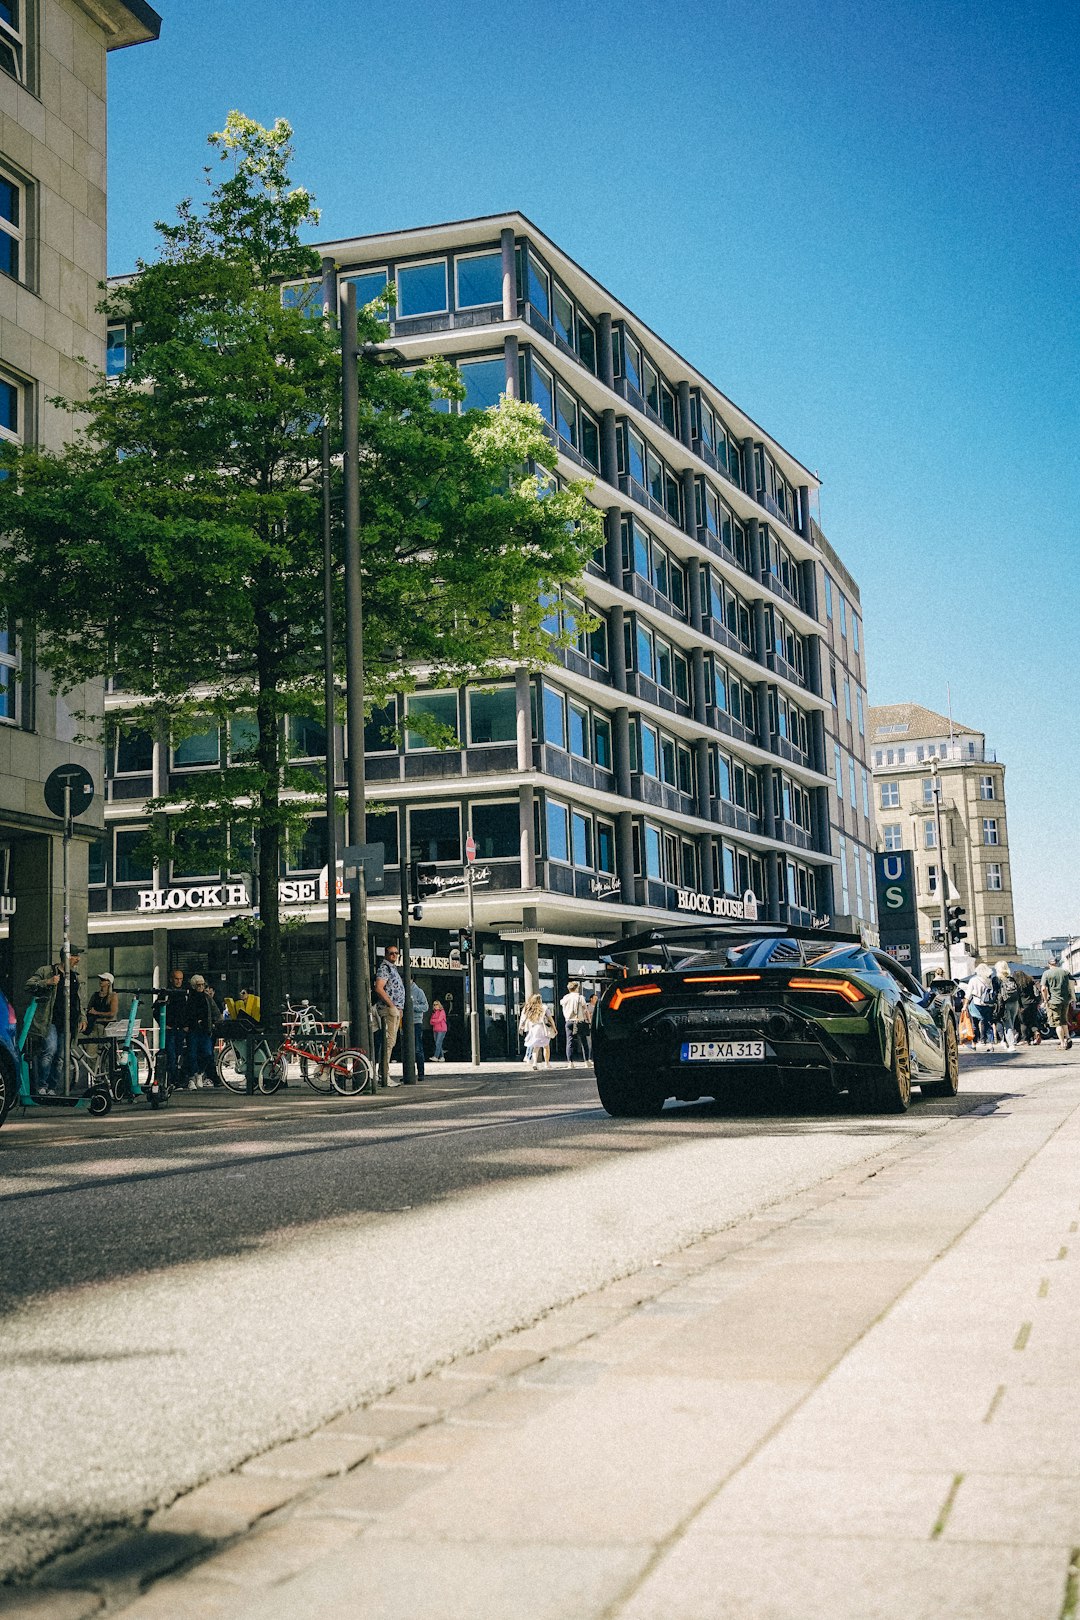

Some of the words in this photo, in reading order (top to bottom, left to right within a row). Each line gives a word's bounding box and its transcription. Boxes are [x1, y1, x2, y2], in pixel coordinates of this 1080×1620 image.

[884, 858, 902, 880] U
[138, 886, 222, 911] BLOCK
[227, 880, 315, 905] HSE
[677, 890, 711, 914] BLOCK
[712, 897, 743, 918] HOUSE
[886, 887, 904, 908] S
[420, 956, 450, 970] HOUSE
[689, 1044, 706, 1058] PI
[716, 1043, 734, 1057] XA
[736, 1043, 762, 1057] 313
